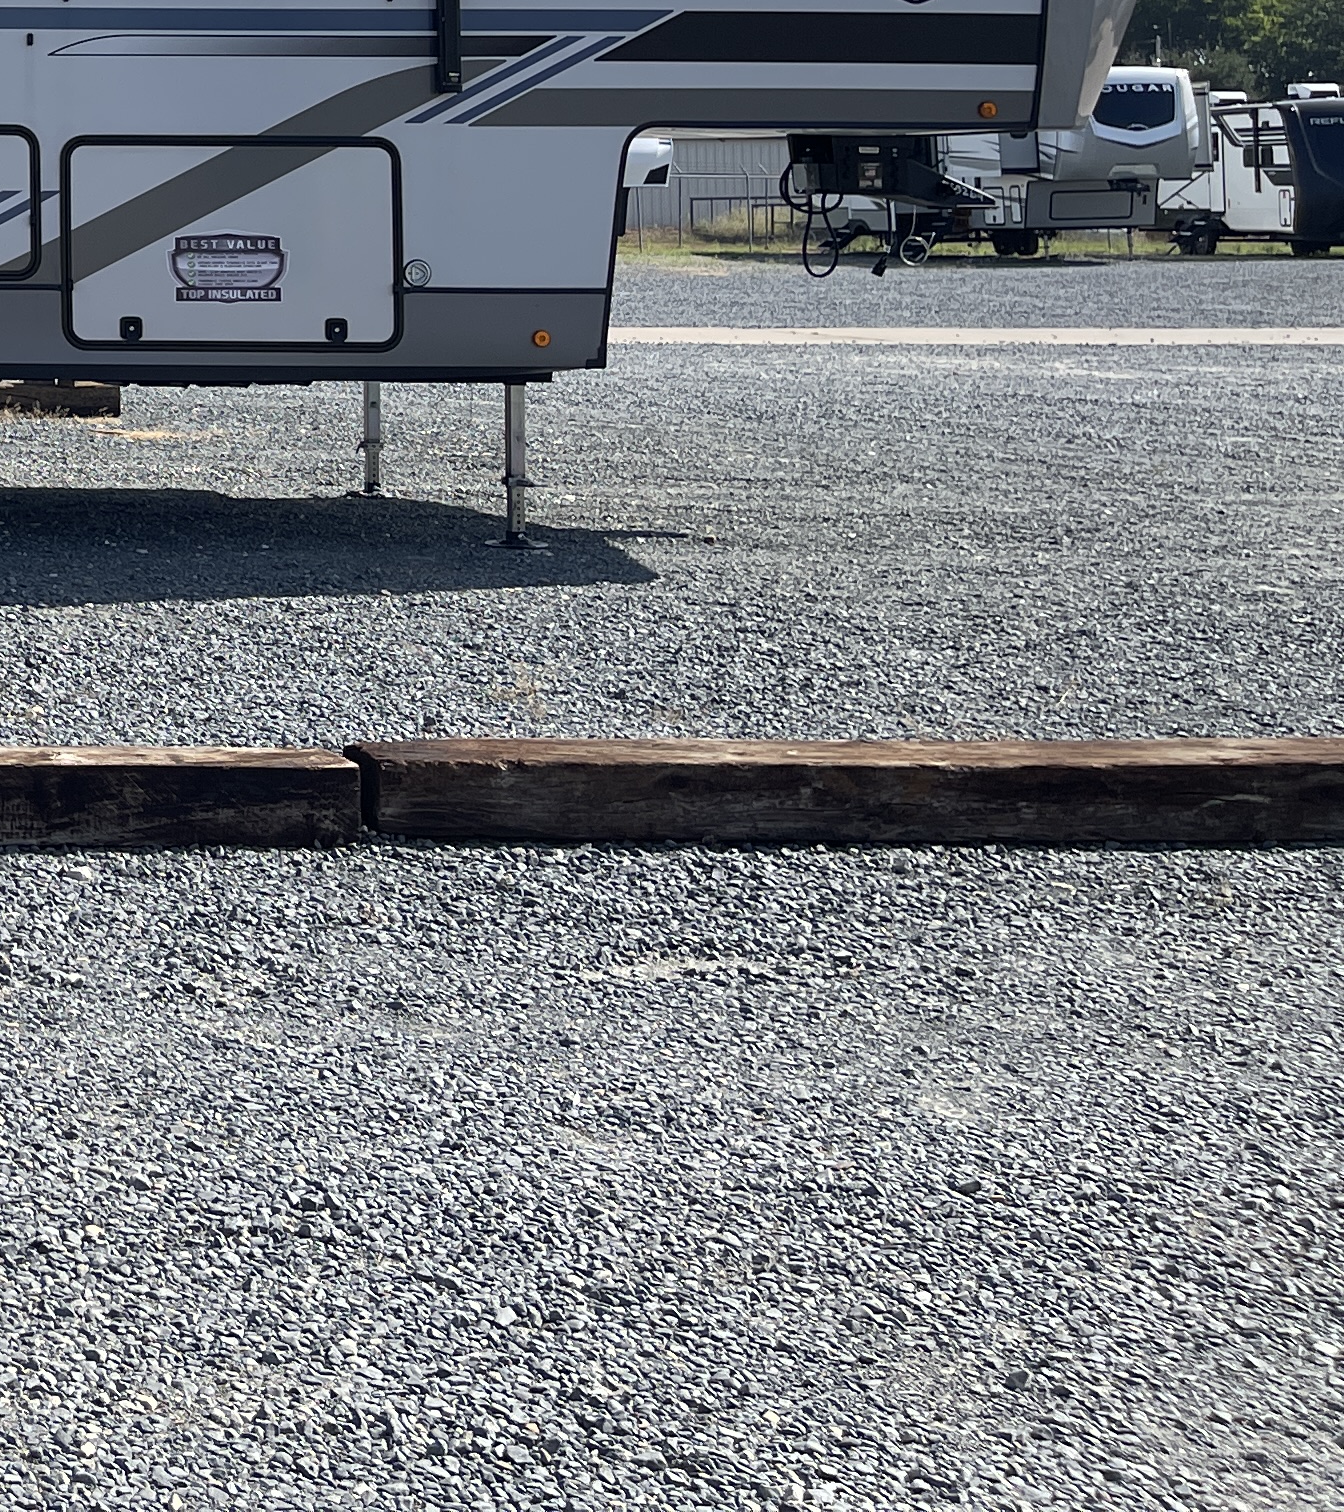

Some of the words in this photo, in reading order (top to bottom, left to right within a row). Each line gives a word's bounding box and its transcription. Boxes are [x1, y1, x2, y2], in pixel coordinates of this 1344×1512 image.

[1101, 84, 1173, 93] OUGAR
[179, 239, 219, 250] BEST
[226, 239, 277, 250] VALUE
[180, 289, 205, 300] TOP
[208, 289, 277, 300] INSULATED
